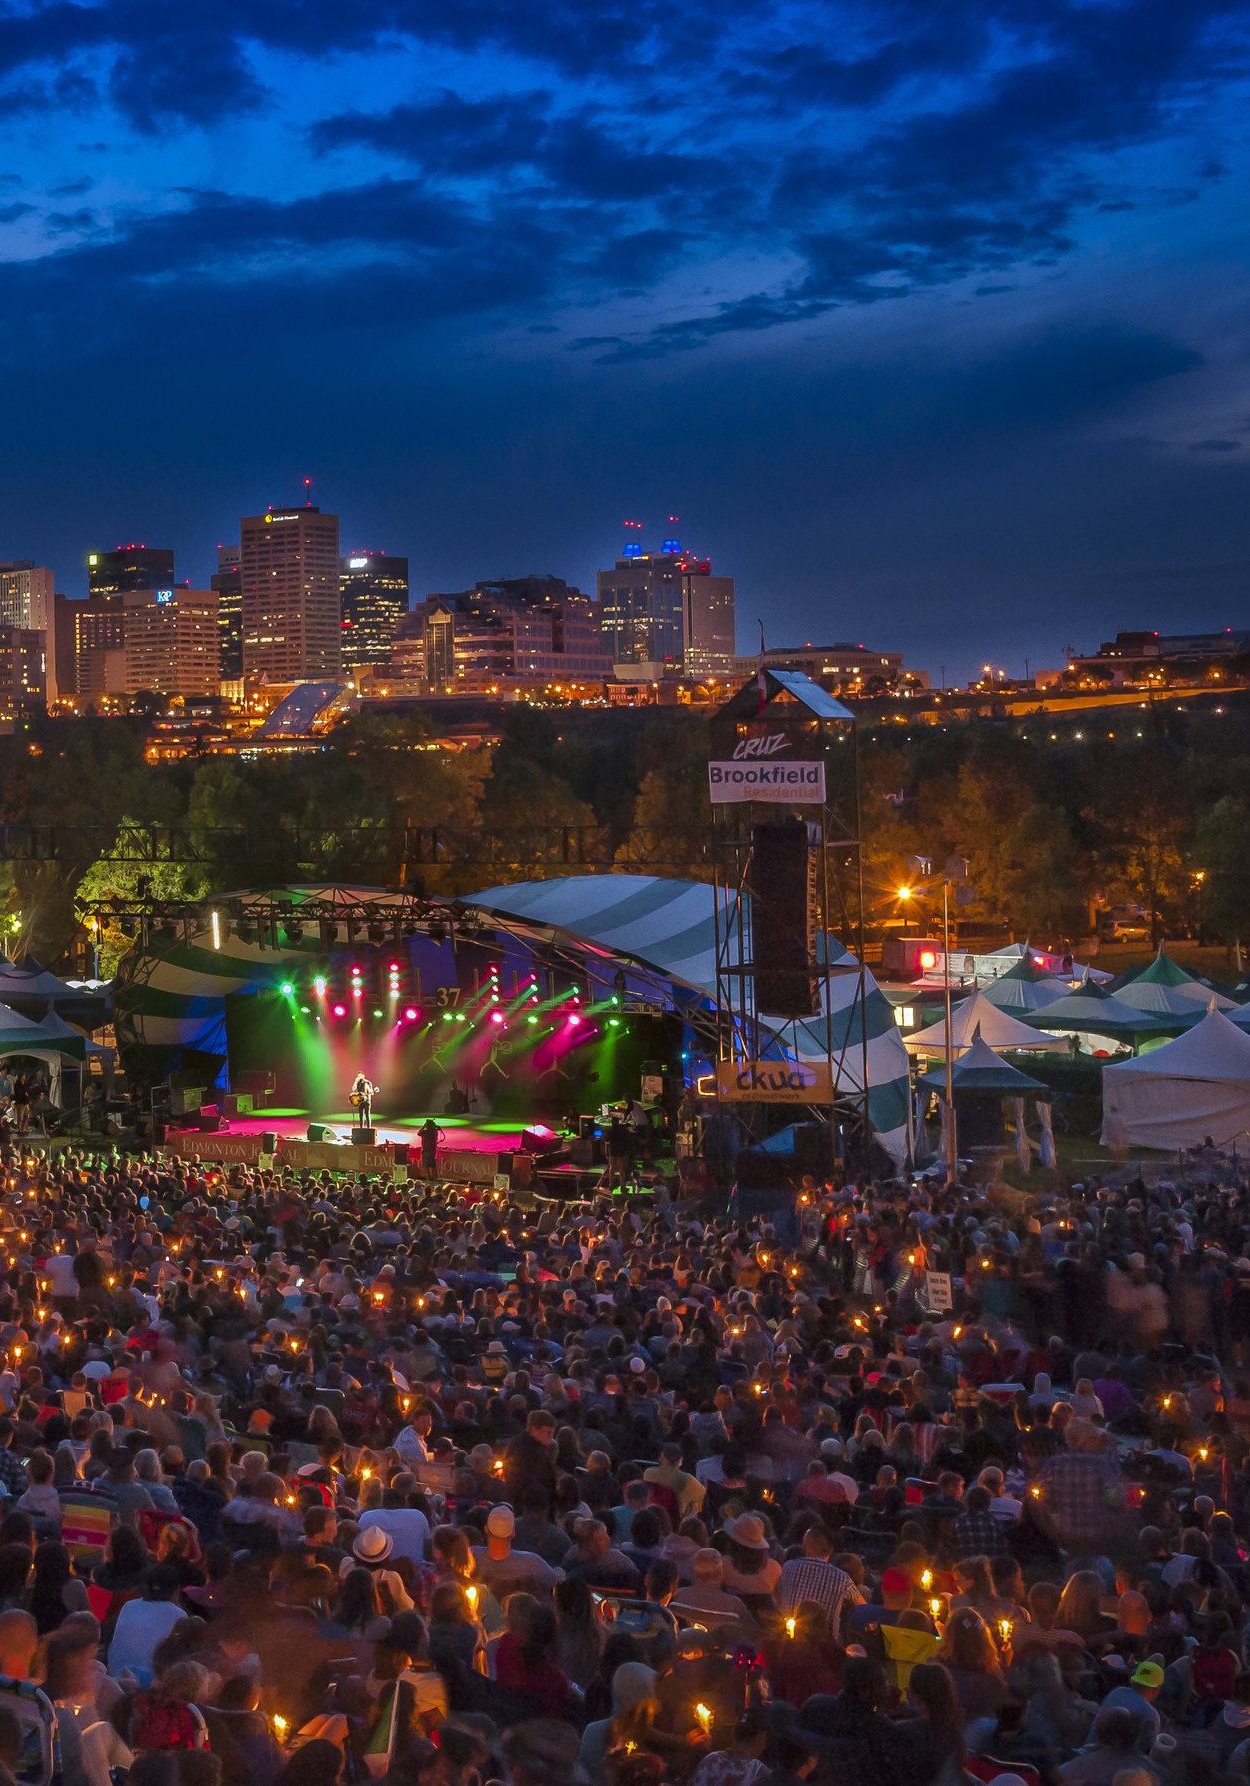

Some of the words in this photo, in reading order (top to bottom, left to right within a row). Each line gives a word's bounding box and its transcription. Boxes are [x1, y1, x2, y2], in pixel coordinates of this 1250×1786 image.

[732, 733, 793, 760] CRUZ
[711, 767, 819, 784] Brookfield
[744, 785, 819, 799] Residential
[436, 987, 461, 1007] 37
[736, 1065, 806, 1091] ckua
[182, 1137, 246, 1157] EDMONTON
